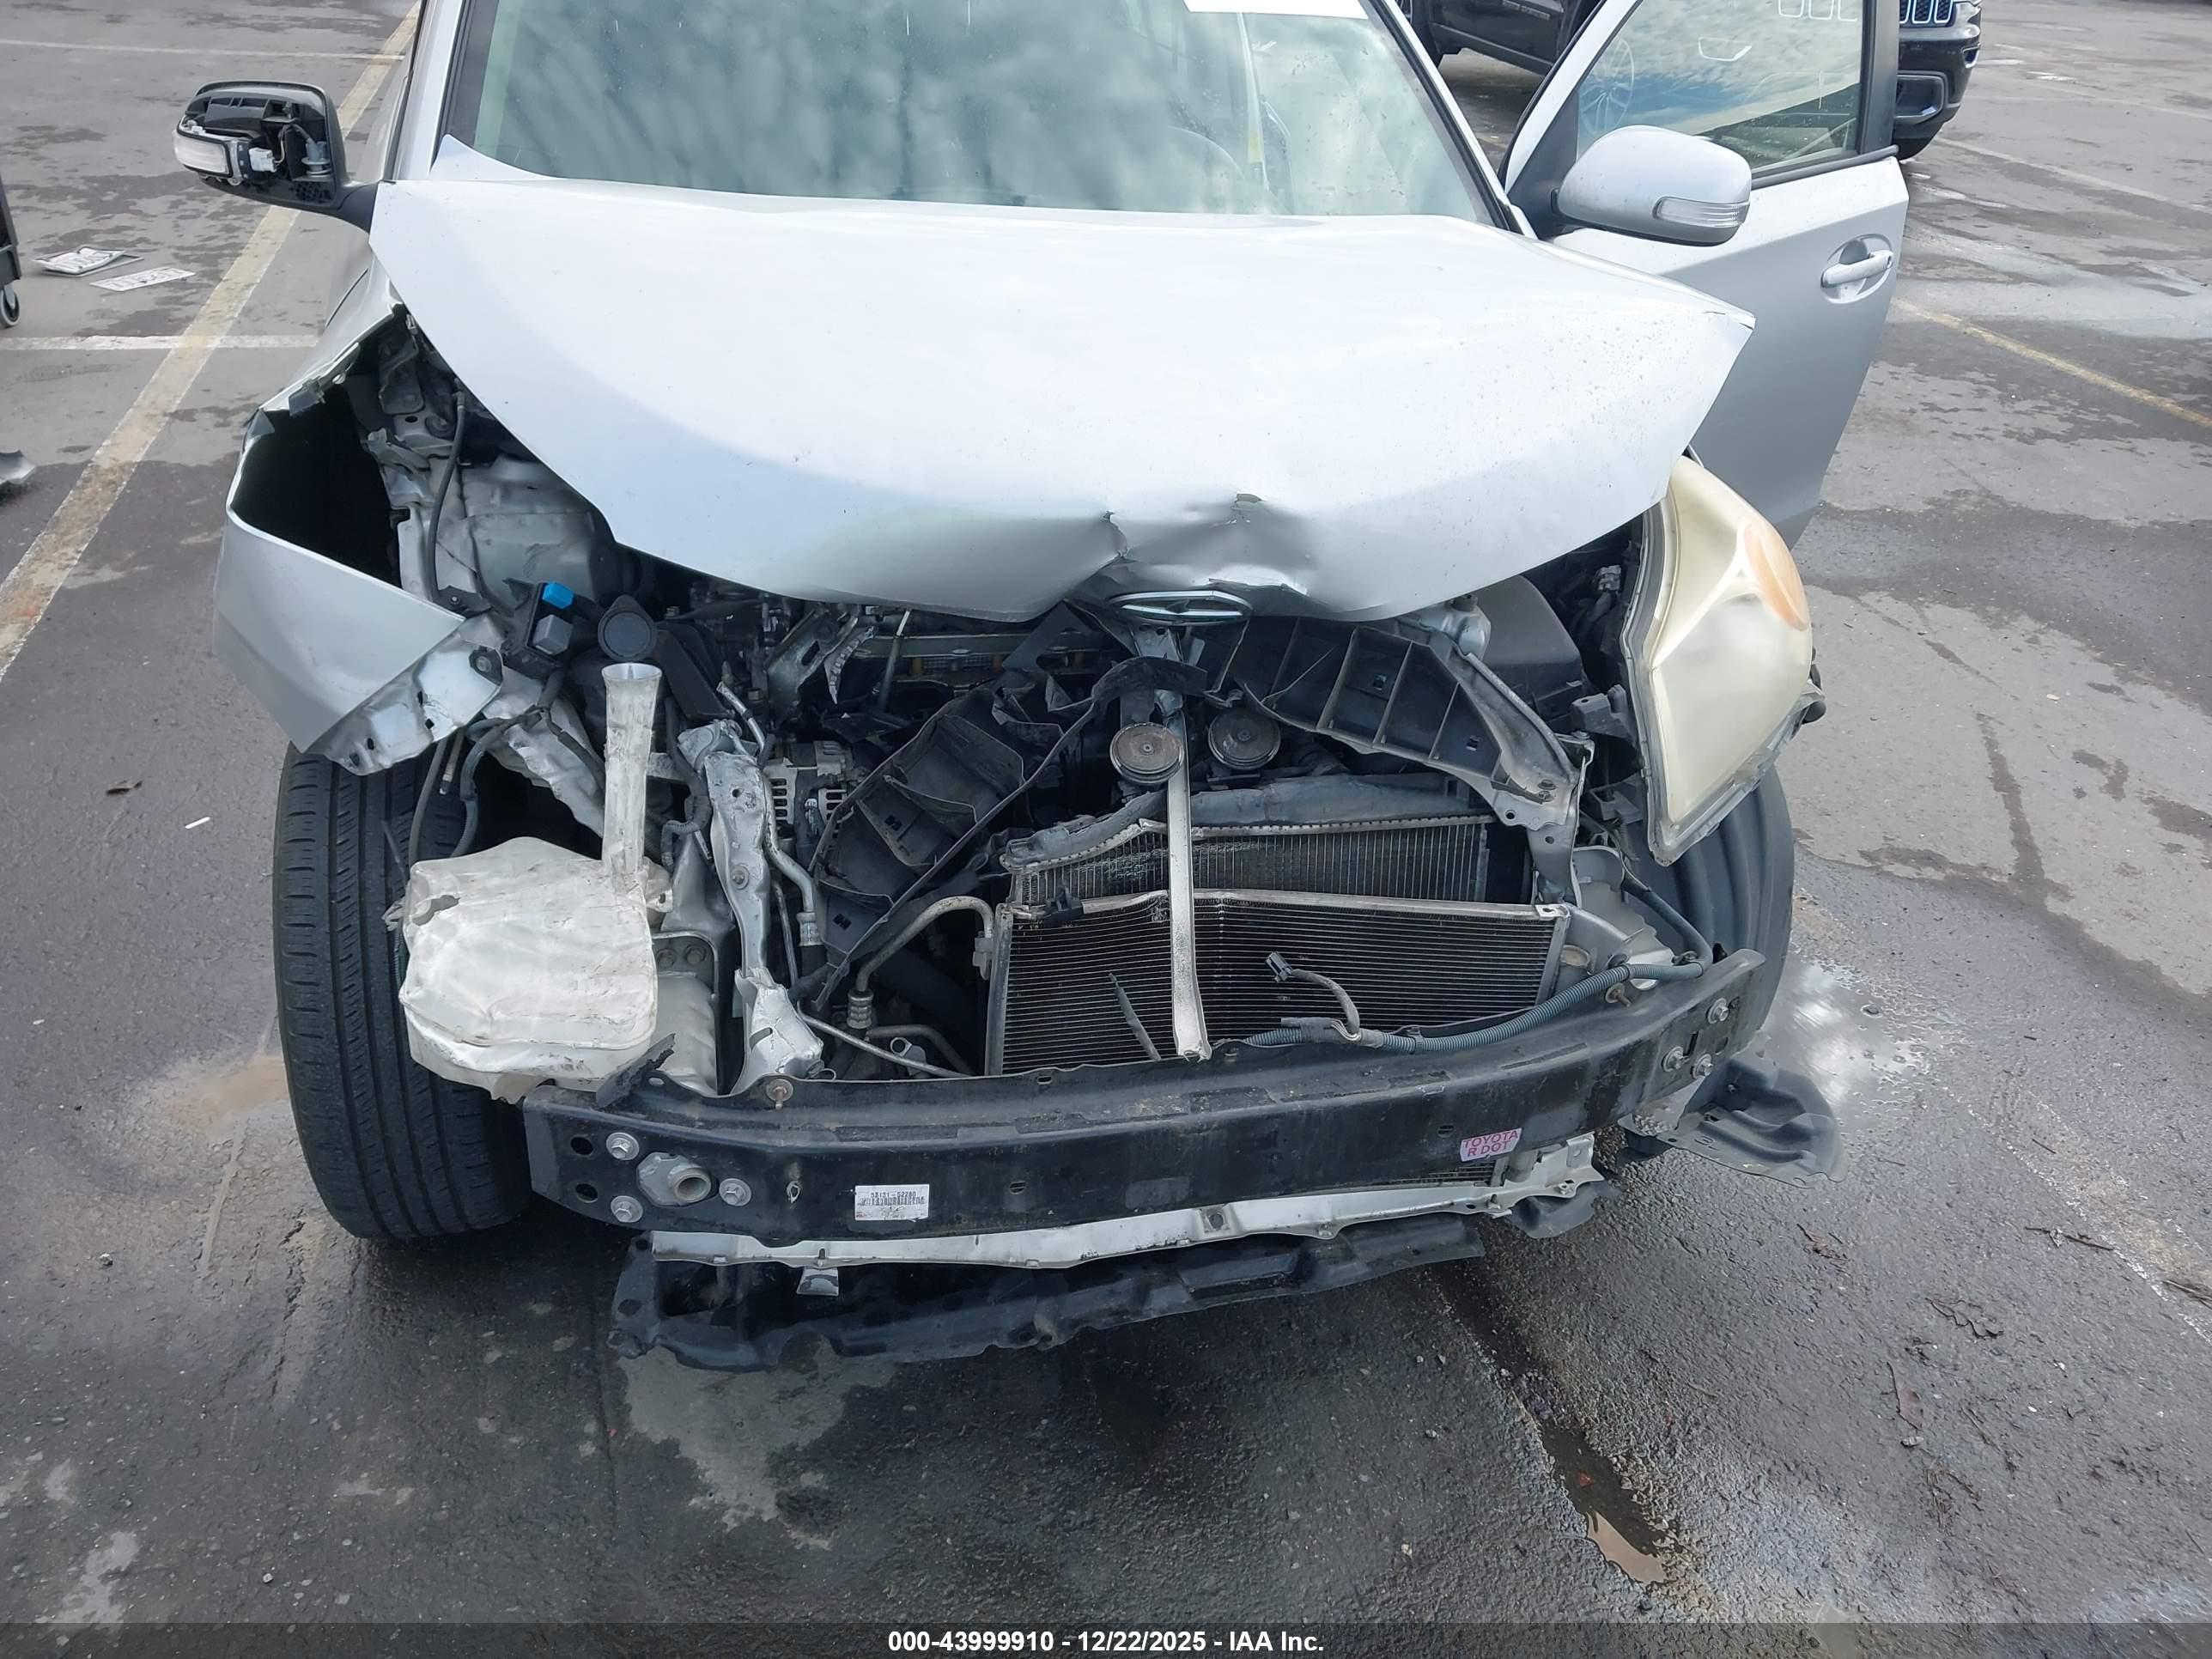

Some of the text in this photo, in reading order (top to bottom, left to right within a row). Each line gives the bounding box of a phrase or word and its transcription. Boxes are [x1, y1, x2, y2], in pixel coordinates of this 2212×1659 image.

[1463, 1130, 1518, 1148] TOYOTA
[1468, 1141, 1511, 1157] R DOT
